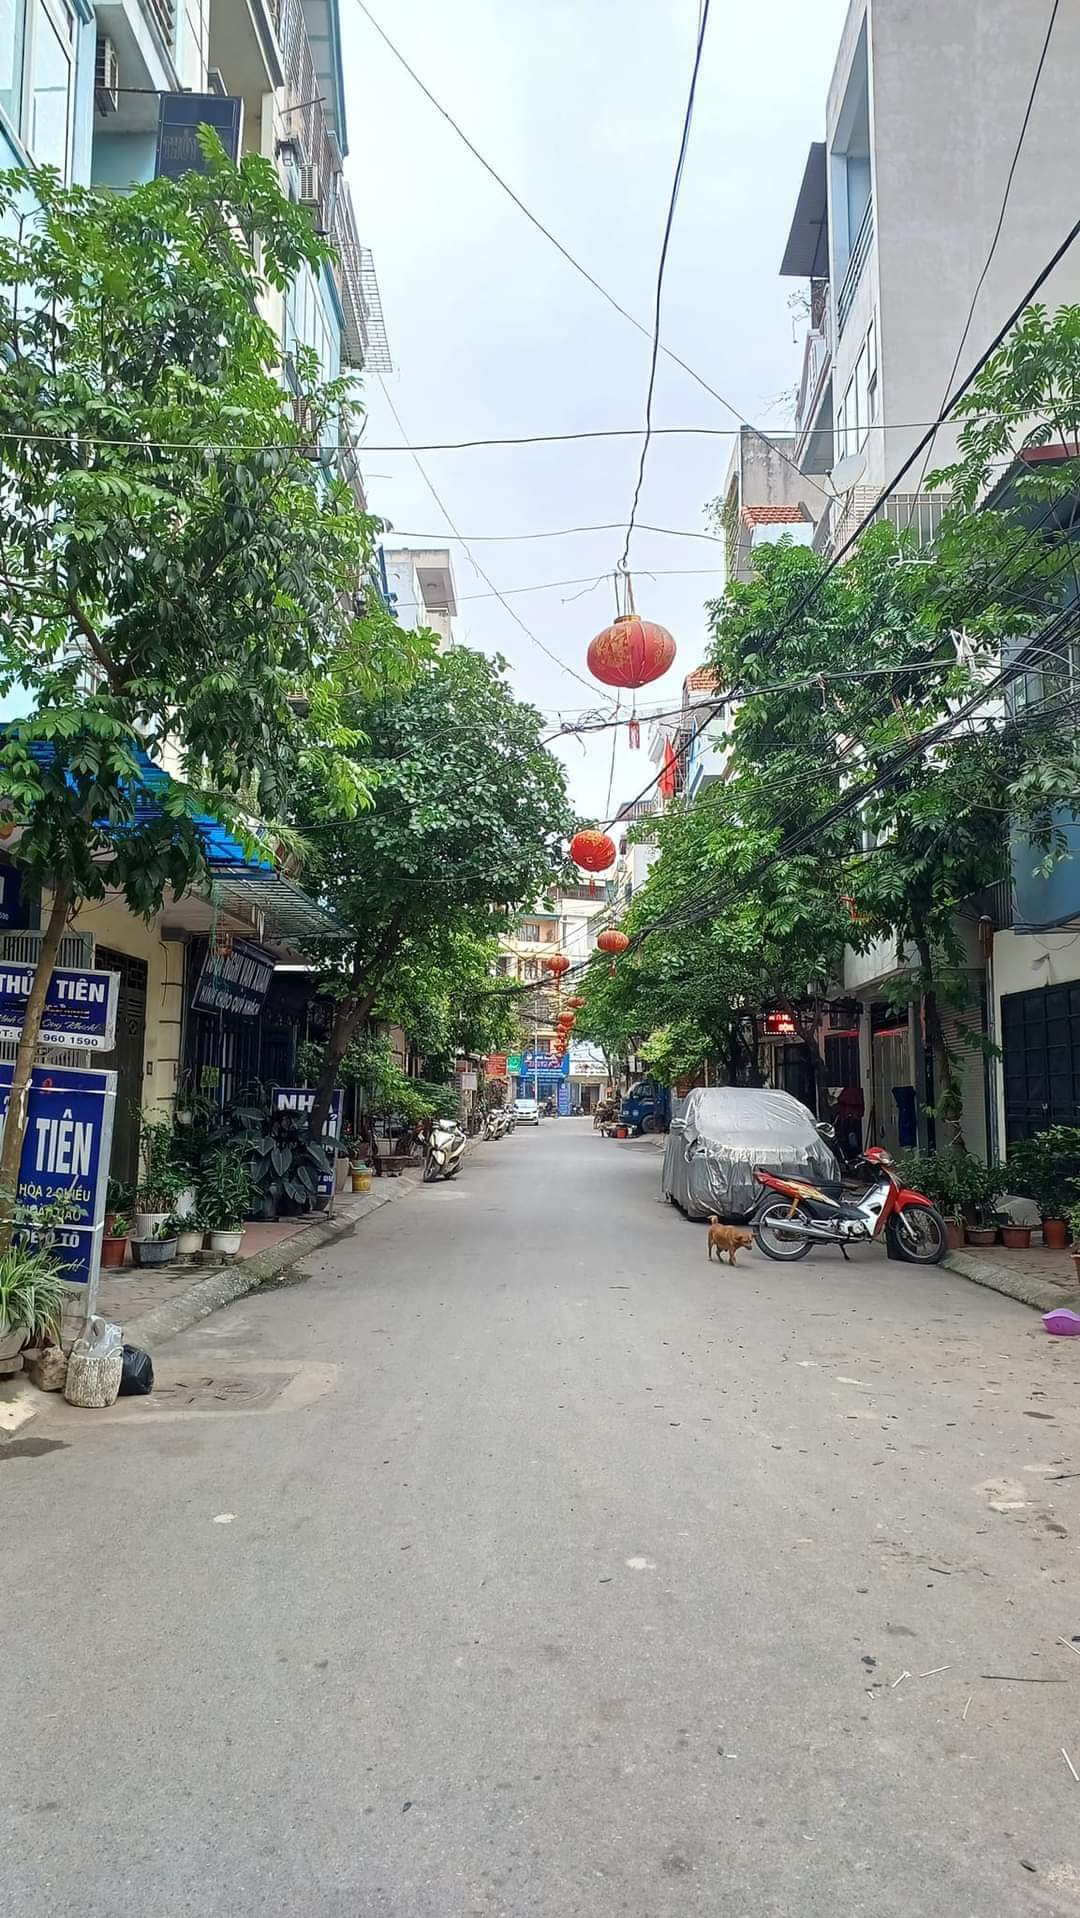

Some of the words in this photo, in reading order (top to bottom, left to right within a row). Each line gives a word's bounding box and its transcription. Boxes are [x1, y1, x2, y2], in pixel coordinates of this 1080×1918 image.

[56, 978, 105, 1003] TIÊN
[43, 1033, 65, 1043] 960
[70, 1036, 98, 1047] 1590
[36, 1108, 93, 1176] TIÊN
[46, 1186, 54, 1198] 2
